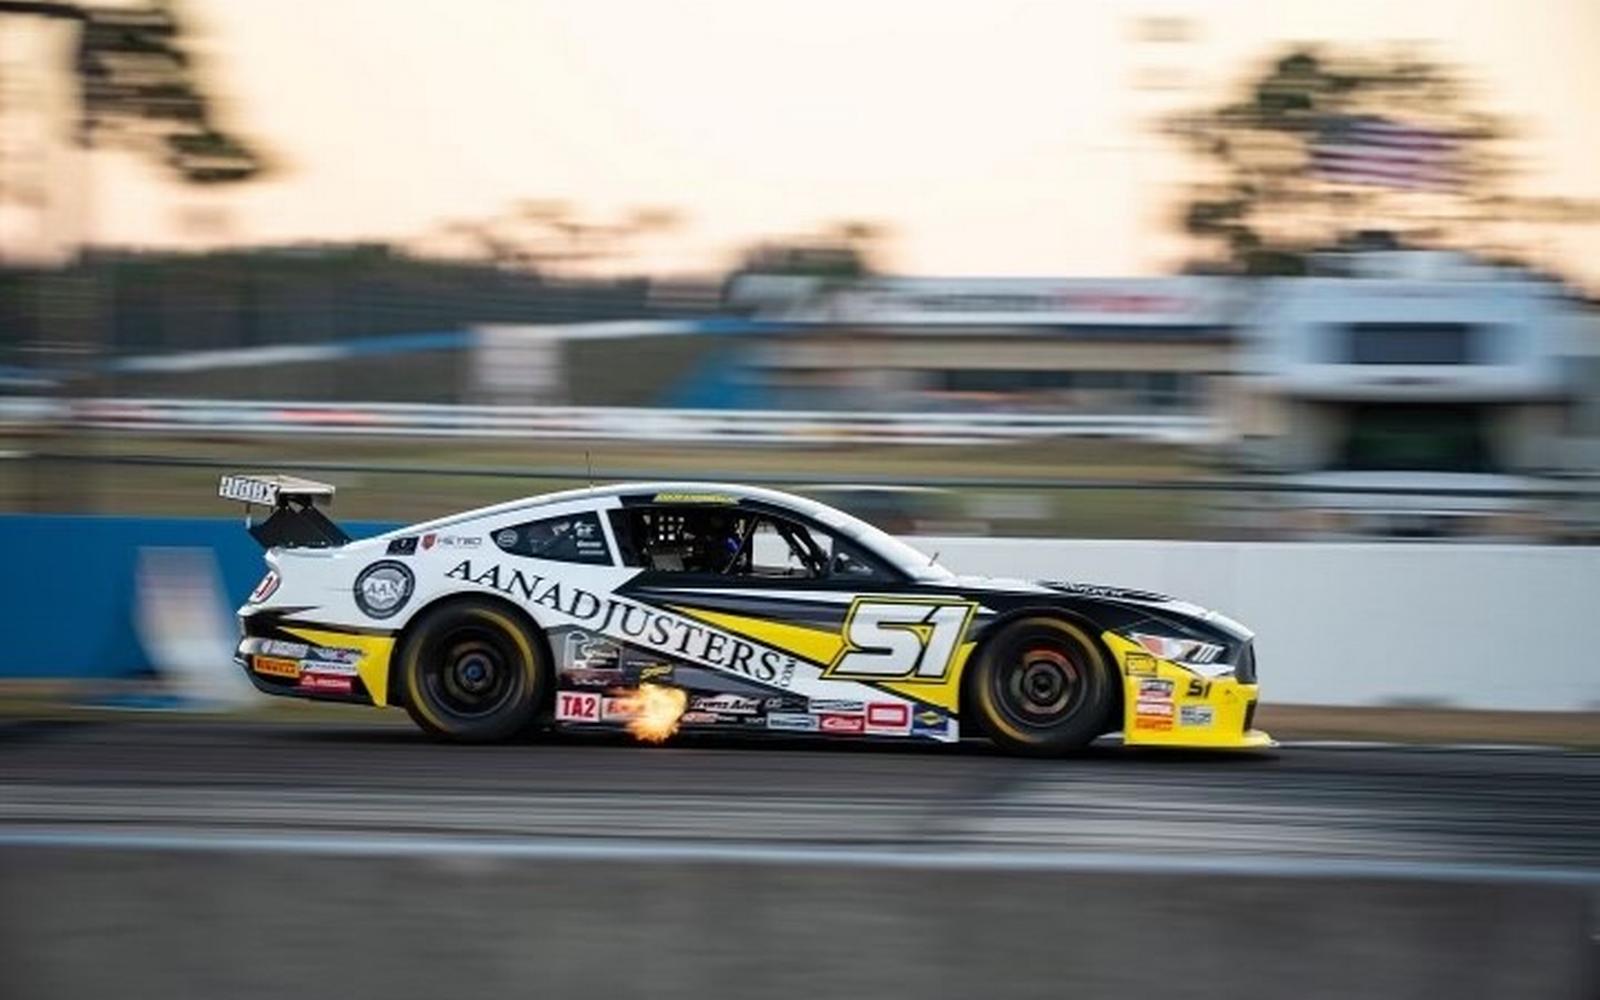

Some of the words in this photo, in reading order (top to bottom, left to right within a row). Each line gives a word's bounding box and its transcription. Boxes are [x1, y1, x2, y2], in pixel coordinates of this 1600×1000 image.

[827, 599, 974, 681] 51
[1187, 679, 1212, 698] 51
[562, 695, 596, 718] TA2
